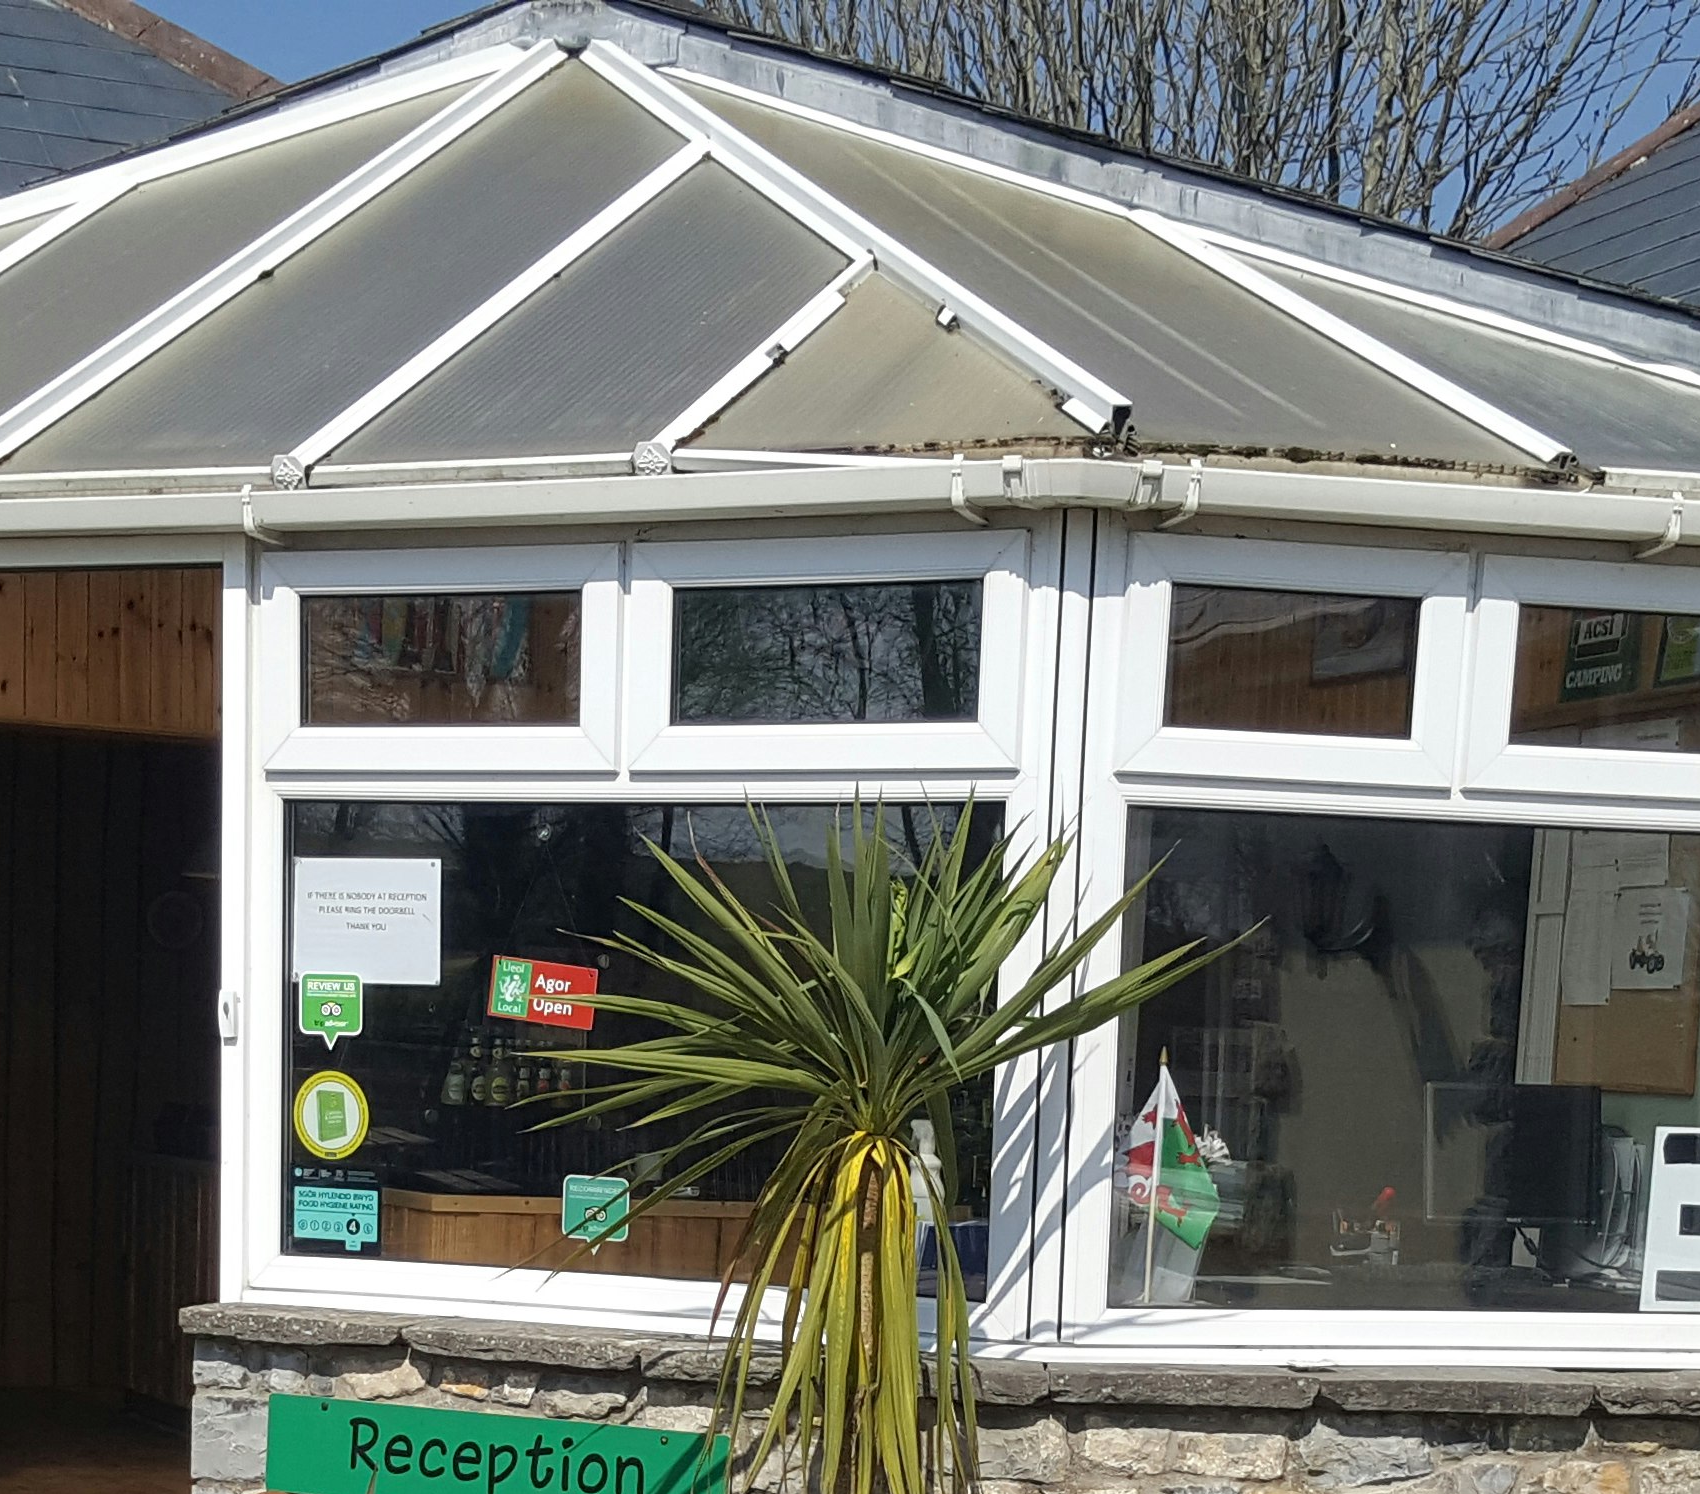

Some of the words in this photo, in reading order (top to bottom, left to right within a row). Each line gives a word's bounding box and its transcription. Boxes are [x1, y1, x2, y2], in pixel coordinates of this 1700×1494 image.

[1565, 663, 1623, 689] CAMPING
[315, 892, 337, 900] THERE
[338, 892, 344, 900] IS
[388, 893, 427, 901] RECEPTION
[344, 906, 361, 914] RING
[378, 907, 415, 915] DOORBELL
[346, 922, 369, 930] THANK
[372, 923, 386, 931] YOU
[307, 981, 340, 991] REVIEW
[344, 982, 355, 991] US
[534, 974, 572, 993] Agor
[497, 1002, 521, 1013] Local
[532, 998, 572, 1016] Open
[298, 1200, 318, 1208] FOOD
[320, 1201, 348, 1209] HYGIENE
[348, 1220, 358, 1233] 4
